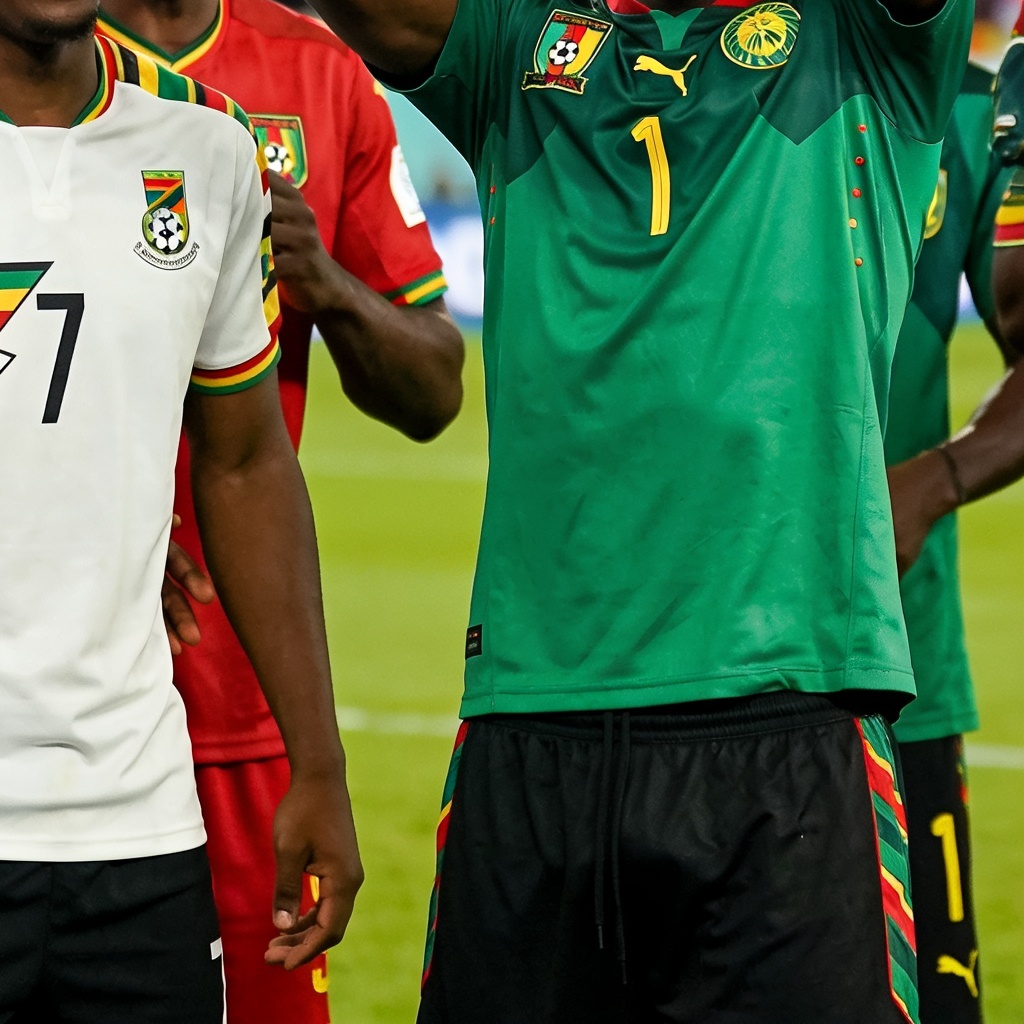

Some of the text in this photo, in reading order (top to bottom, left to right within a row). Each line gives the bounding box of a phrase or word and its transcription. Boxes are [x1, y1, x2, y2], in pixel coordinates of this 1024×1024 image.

[631, 116, 670, 236] 1
[36, 293, 85, 424] 7
[931, 812, 964, 922] 1
